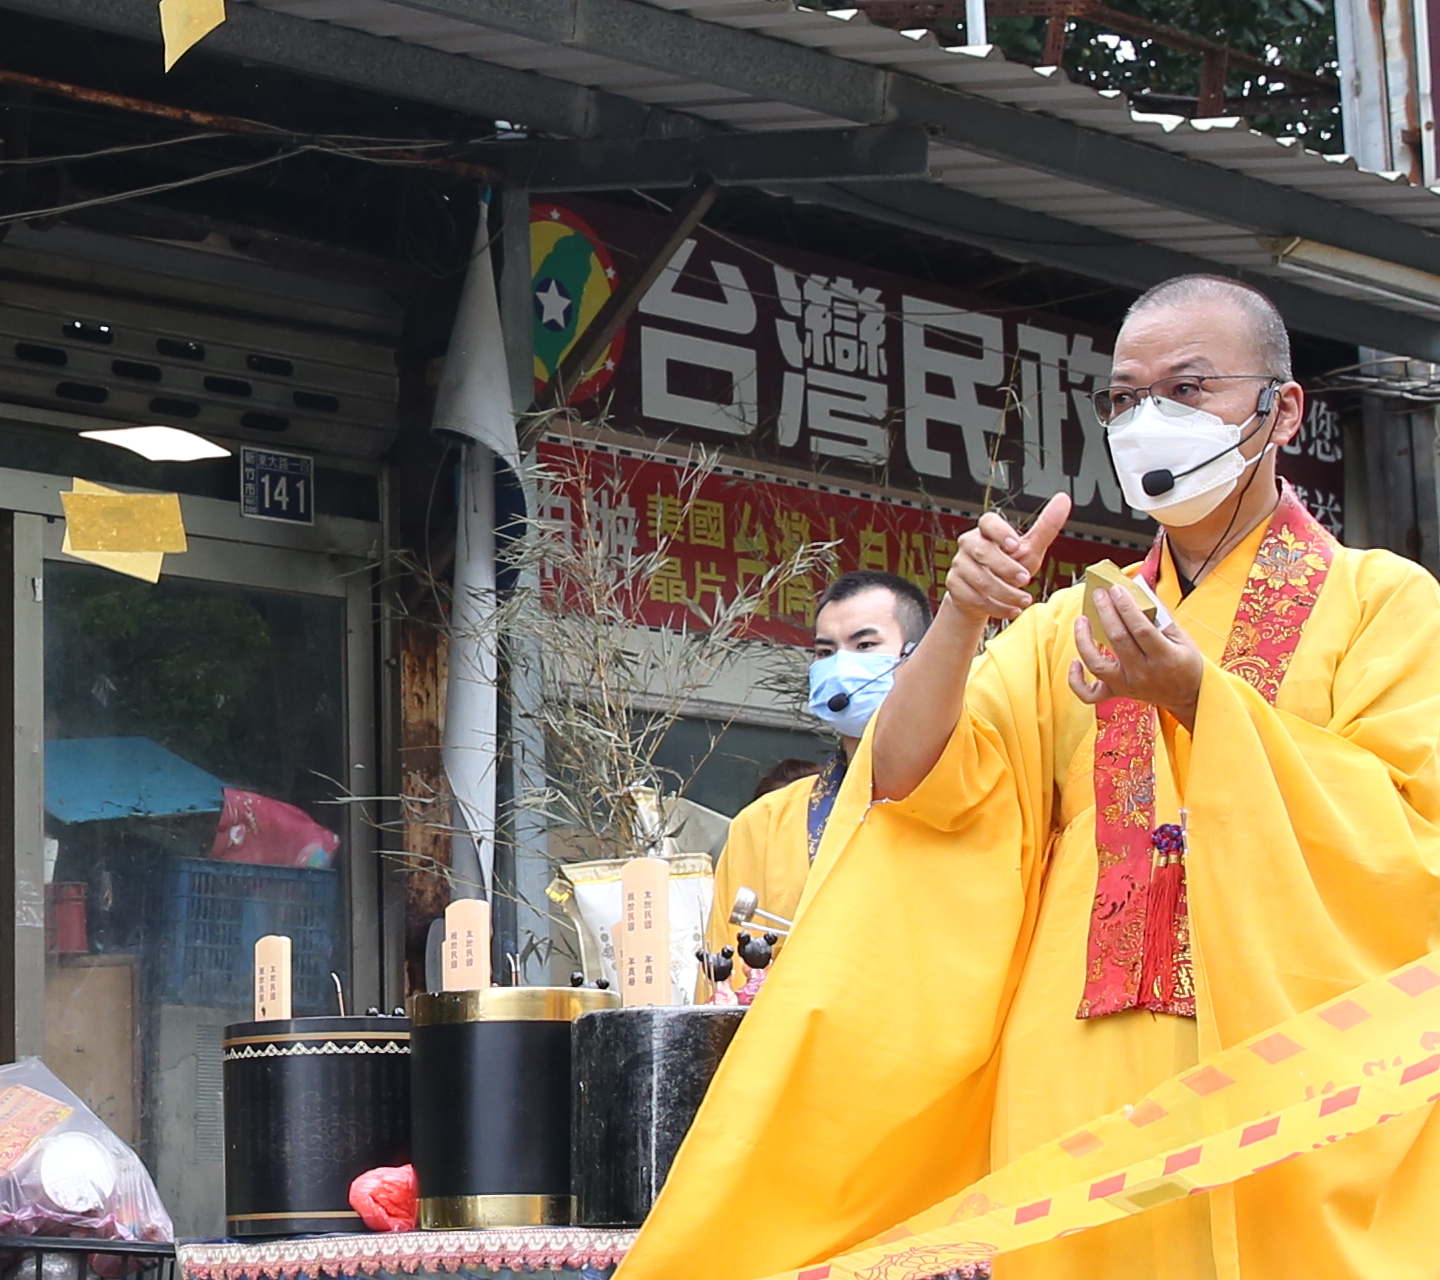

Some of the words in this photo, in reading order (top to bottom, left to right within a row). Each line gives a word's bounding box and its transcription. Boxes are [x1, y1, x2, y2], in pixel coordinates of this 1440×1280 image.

[639, 239, 1152, 517] 台灣民政
[260, 473, 306, 514] 141
[646, 492, 728, 550] 美國
[649, 554, 729, 608] 晶片
